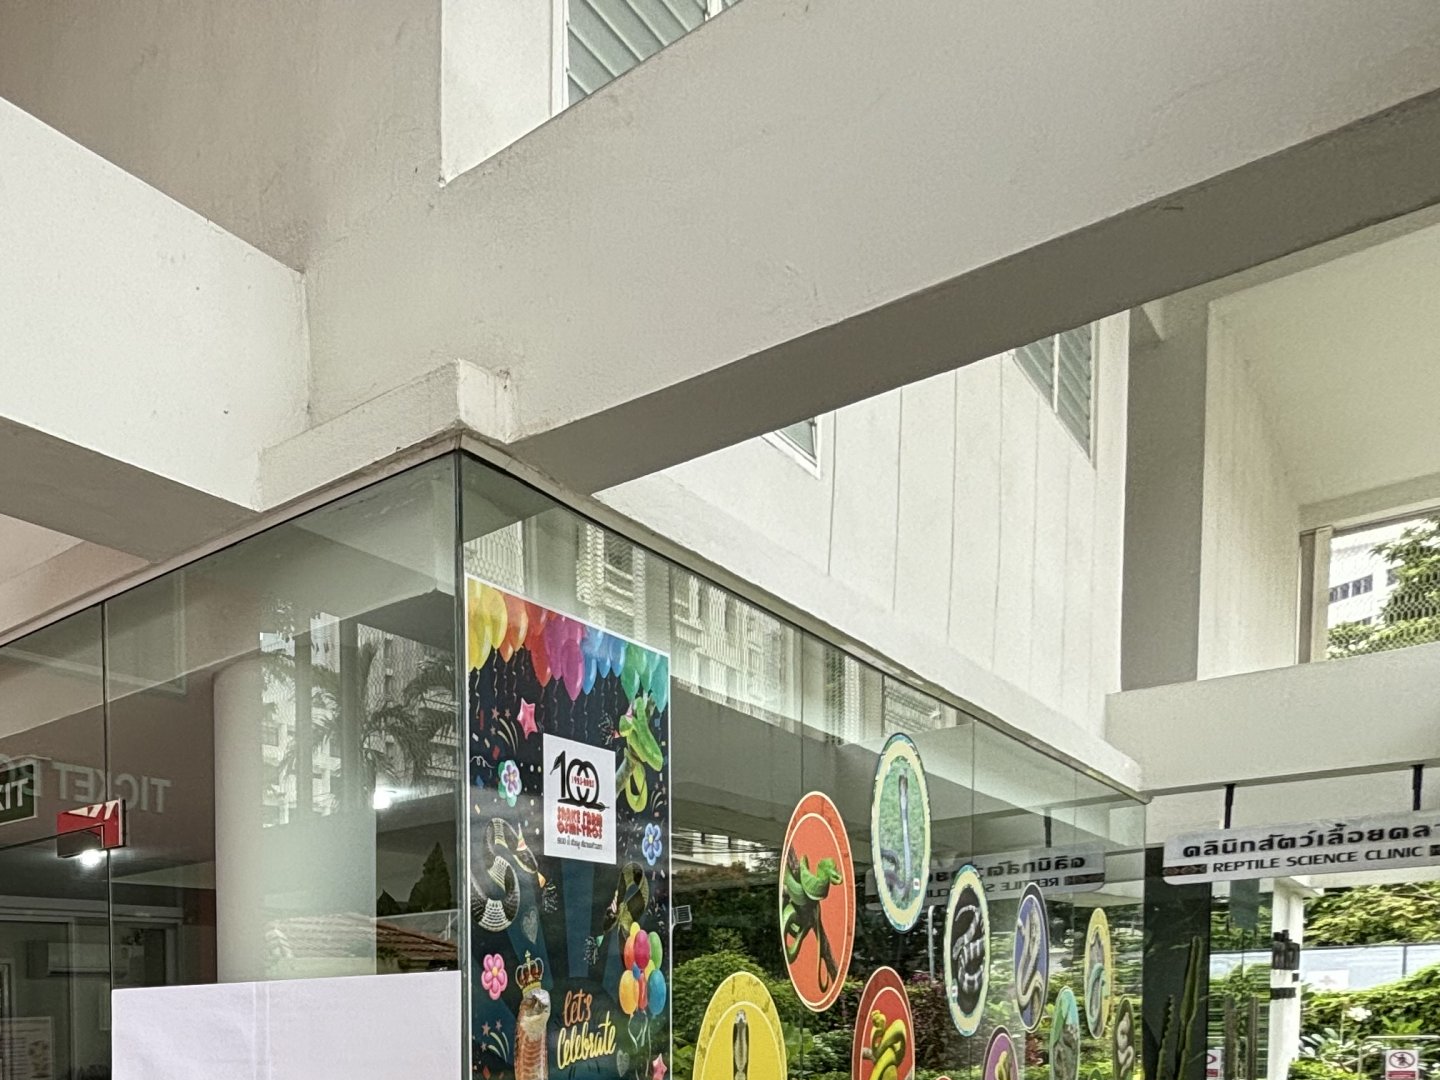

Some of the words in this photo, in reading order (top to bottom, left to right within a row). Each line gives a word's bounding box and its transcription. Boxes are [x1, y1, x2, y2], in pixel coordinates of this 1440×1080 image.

[1213, 856, 1280, 873] REPTILE
[1286, 850, 1359, 867] SCIENCE
[1364, 845, 1424, 861] CLINIC
